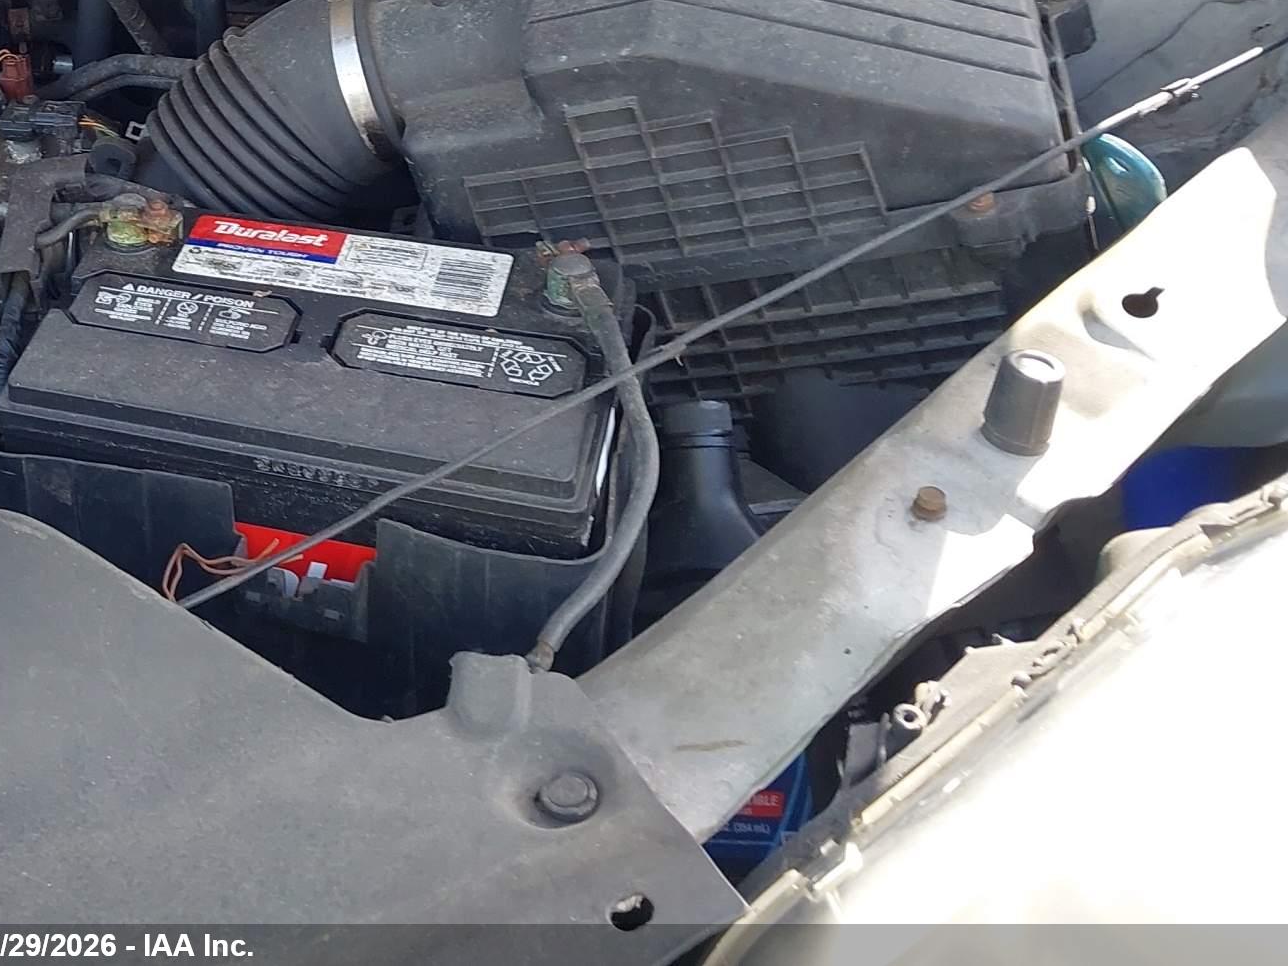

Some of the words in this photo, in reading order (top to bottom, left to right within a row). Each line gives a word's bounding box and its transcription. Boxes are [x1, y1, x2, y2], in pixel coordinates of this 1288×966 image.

[213, 220, 329, 247] Duralast
[216, 242, 265, 254] PROVEN
[266, 249, 310, 259] TOUGH
[136, 285, 192, 300] DANGER
[203, 294, 255, 308] POISON
